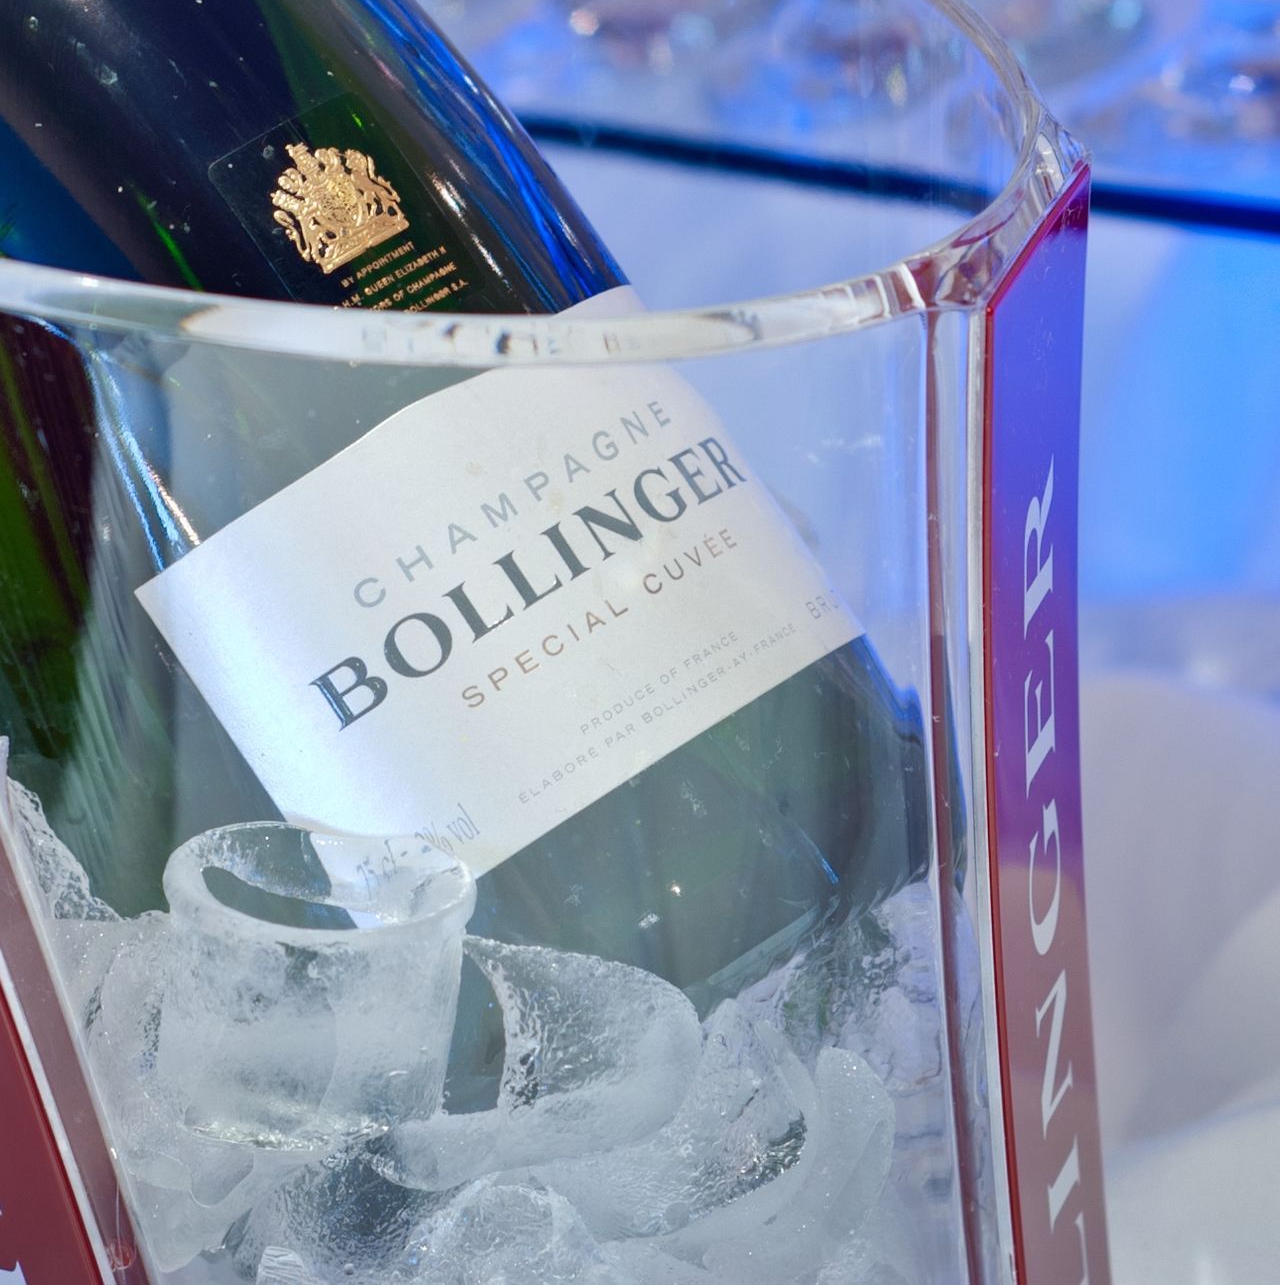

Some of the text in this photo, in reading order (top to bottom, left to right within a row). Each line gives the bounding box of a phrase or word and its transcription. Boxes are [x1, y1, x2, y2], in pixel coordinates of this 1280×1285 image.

[340, 240, 415, 288] BY APPOINTMENT
[363, 274, 395, 296] QUEEN
[394, 248, 440, 279] ELIZABETH
[392, 289, 405, 302] OF
[406, 261, 458, 294] CHAMPAGNE
[352, 400, 672, 609] CHAMPAGNE
[308, 436, 748, 733] BOLLINGER
[460, 527, 739, 709] SPECIAL CUVÉE
[579, 630, 739, 736] PRODUCE OF FRANCE
[604, 723, 637, 749] PAR
[446, 801, 481, 845] vol
